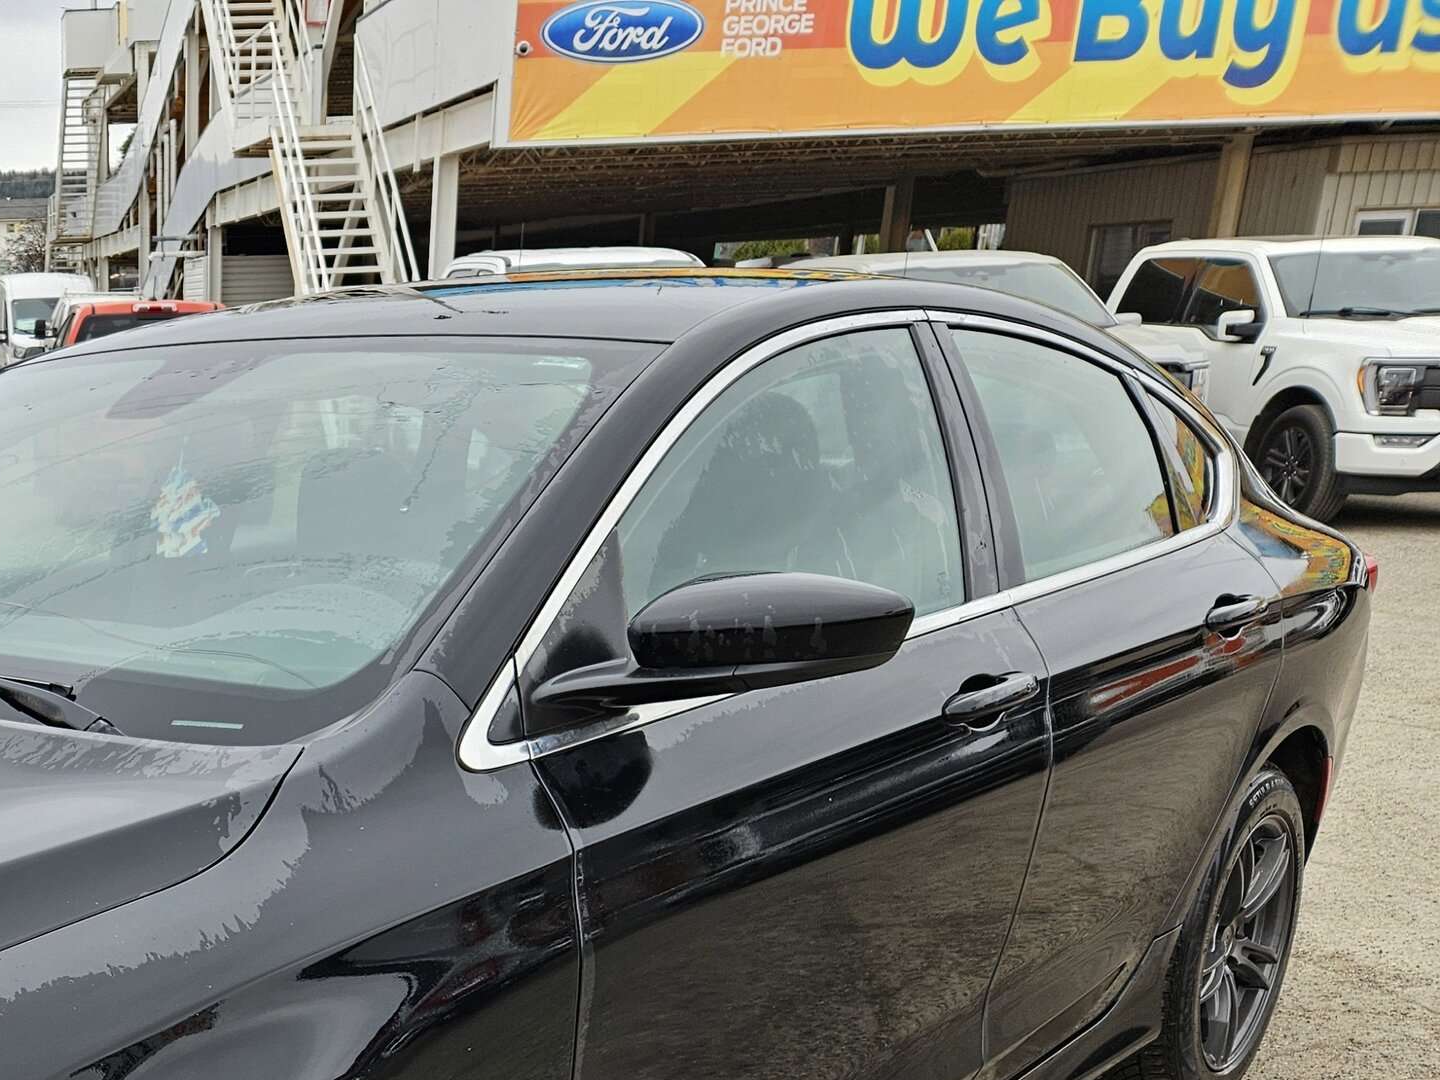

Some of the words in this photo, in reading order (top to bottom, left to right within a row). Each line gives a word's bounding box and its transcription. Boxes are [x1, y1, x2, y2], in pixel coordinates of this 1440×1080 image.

[572, 6, 673, 51] Ford
[722, 14, 815, 37] GEORGE
[720, 37, 783, 58] FORD
[1073, 0, 1296, 89] Buy
